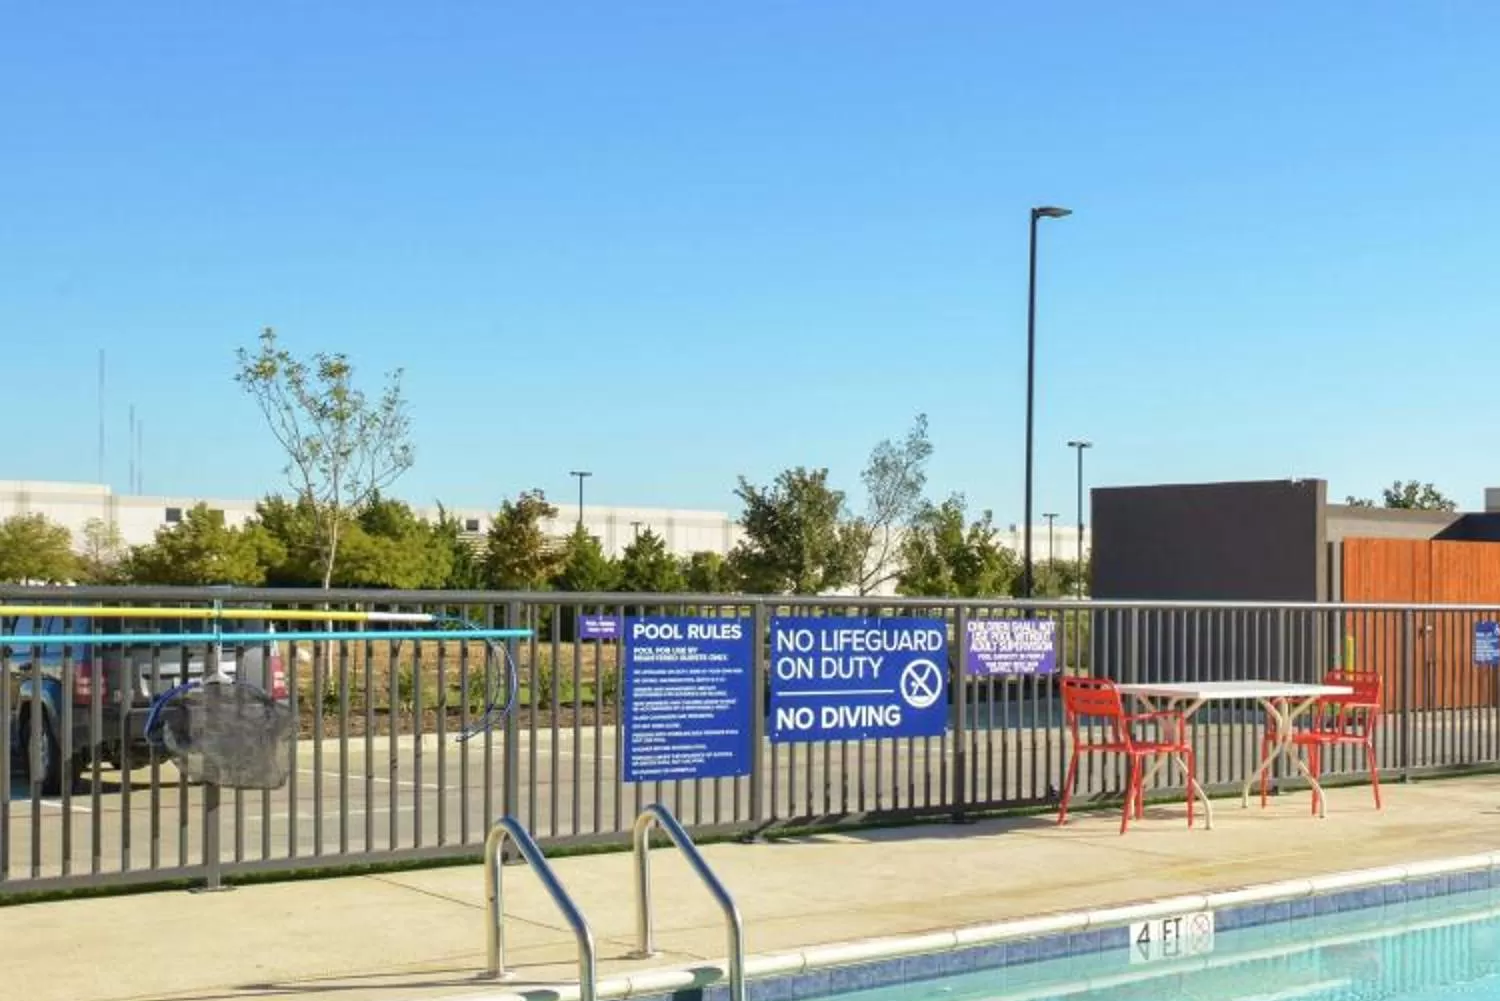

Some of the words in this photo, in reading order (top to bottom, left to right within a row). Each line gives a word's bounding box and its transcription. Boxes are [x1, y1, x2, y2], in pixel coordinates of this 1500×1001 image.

[633, 623, 683, 639] POOL
[687, 623, 742, 639] RULES
[776, 629, 814, 653] NO
[821, 629, 943, 651] LIFEGUARD
[777, 656, 814, 680] ON
[821, 656, 884, 679] DUTY
[776, 707, 814, 730] NO
[821, 704, 901, 729] DIVING
[1136, 922, 1150, 943] 4
[1163, 917, 1182, 941] FT
